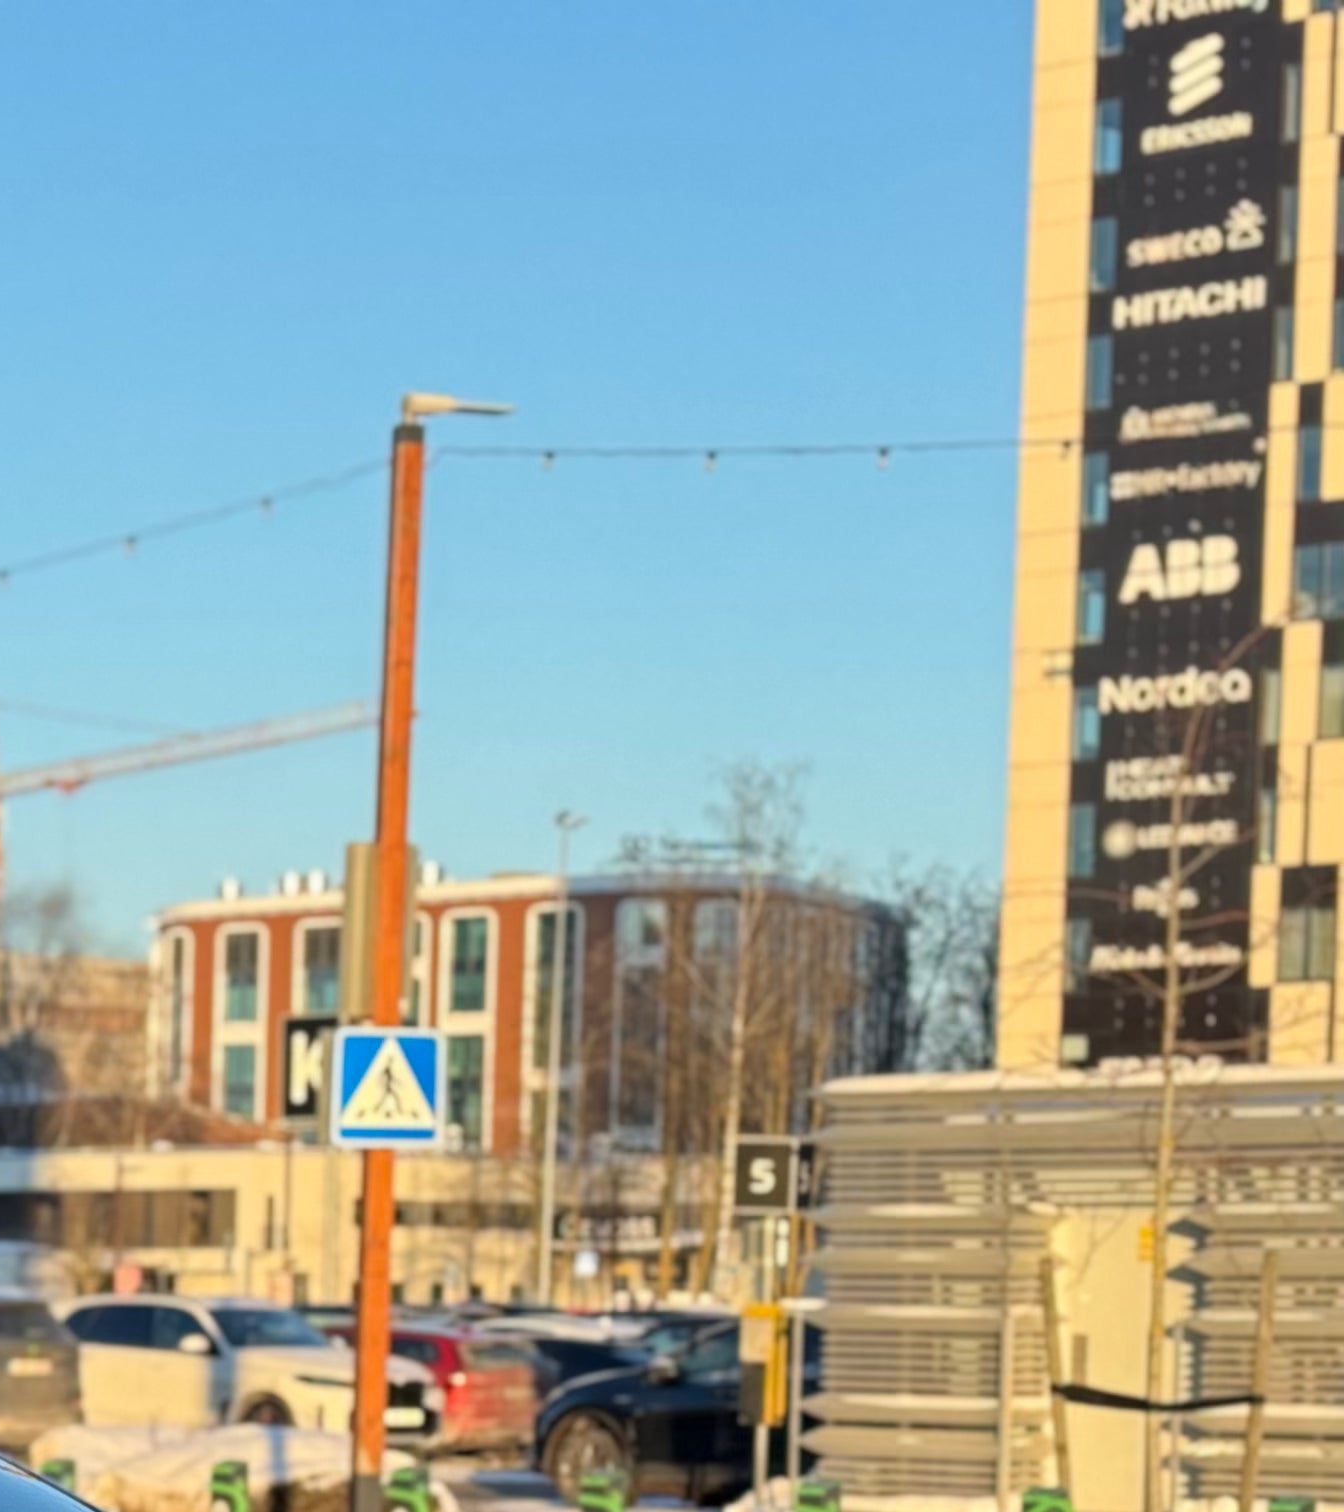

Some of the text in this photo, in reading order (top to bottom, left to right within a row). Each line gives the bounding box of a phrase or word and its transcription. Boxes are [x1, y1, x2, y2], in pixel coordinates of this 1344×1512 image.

[1112, 275, 1267, 330] HITACHI
[1118, 535, 1241, 605] ABB
[749, 1156, 777, 1195] S
